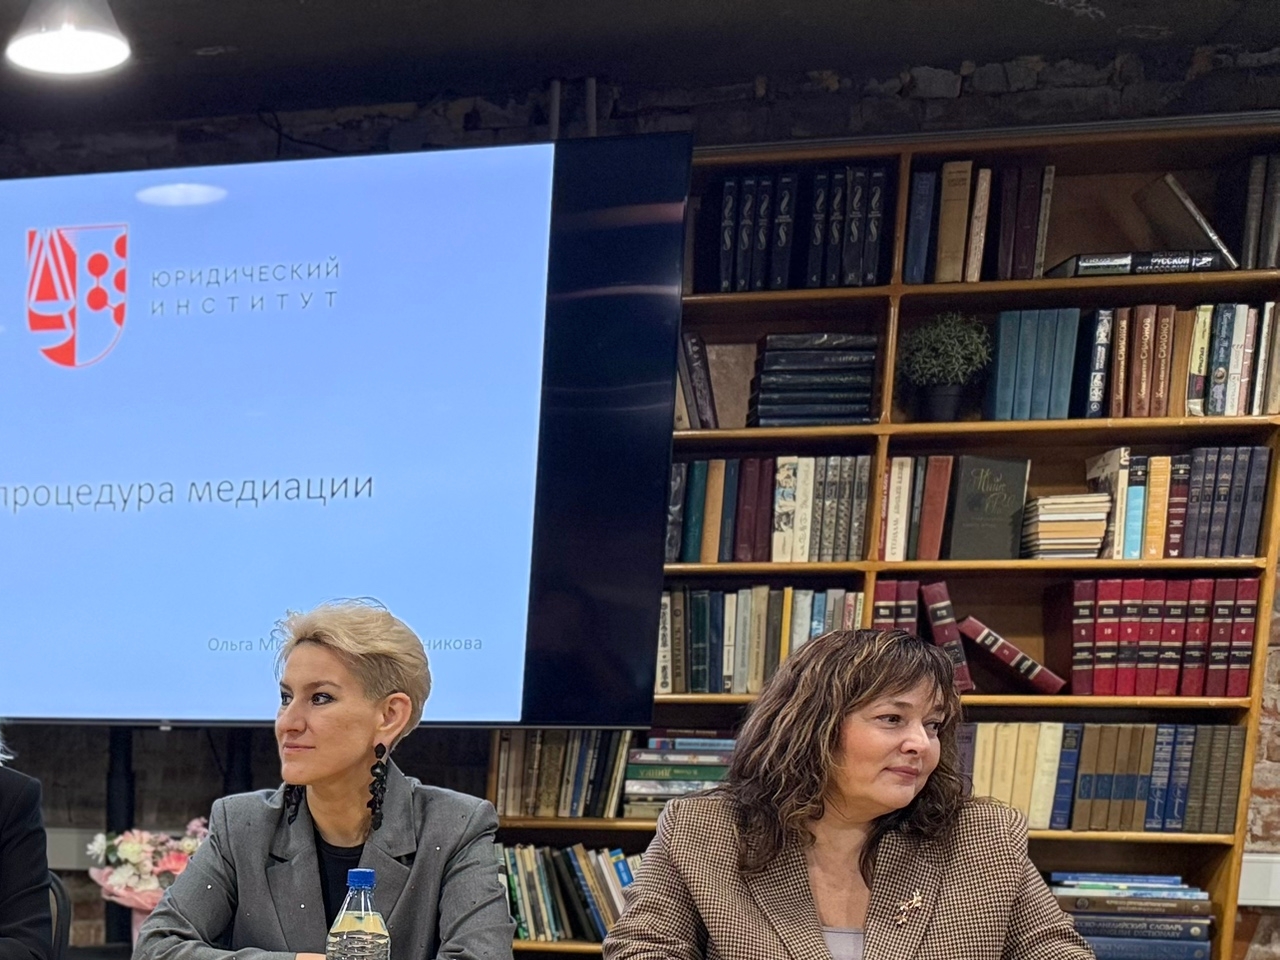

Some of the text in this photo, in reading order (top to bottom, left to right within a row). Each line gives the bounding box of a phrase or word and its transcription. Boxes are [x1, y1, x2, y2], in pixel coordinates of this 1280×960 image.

[151, 255, 340, 287] ЮРИДИЧЕСКИЙ
[150, 290, 337, 316] ИНСТИТУТ
[186, 475, 374, 508] медиации
[207, 637, 254, 652] Ольга
[422, 638, 483, 651] никова
[1149, 922, 1184, 933] СЛОВАРЬ
